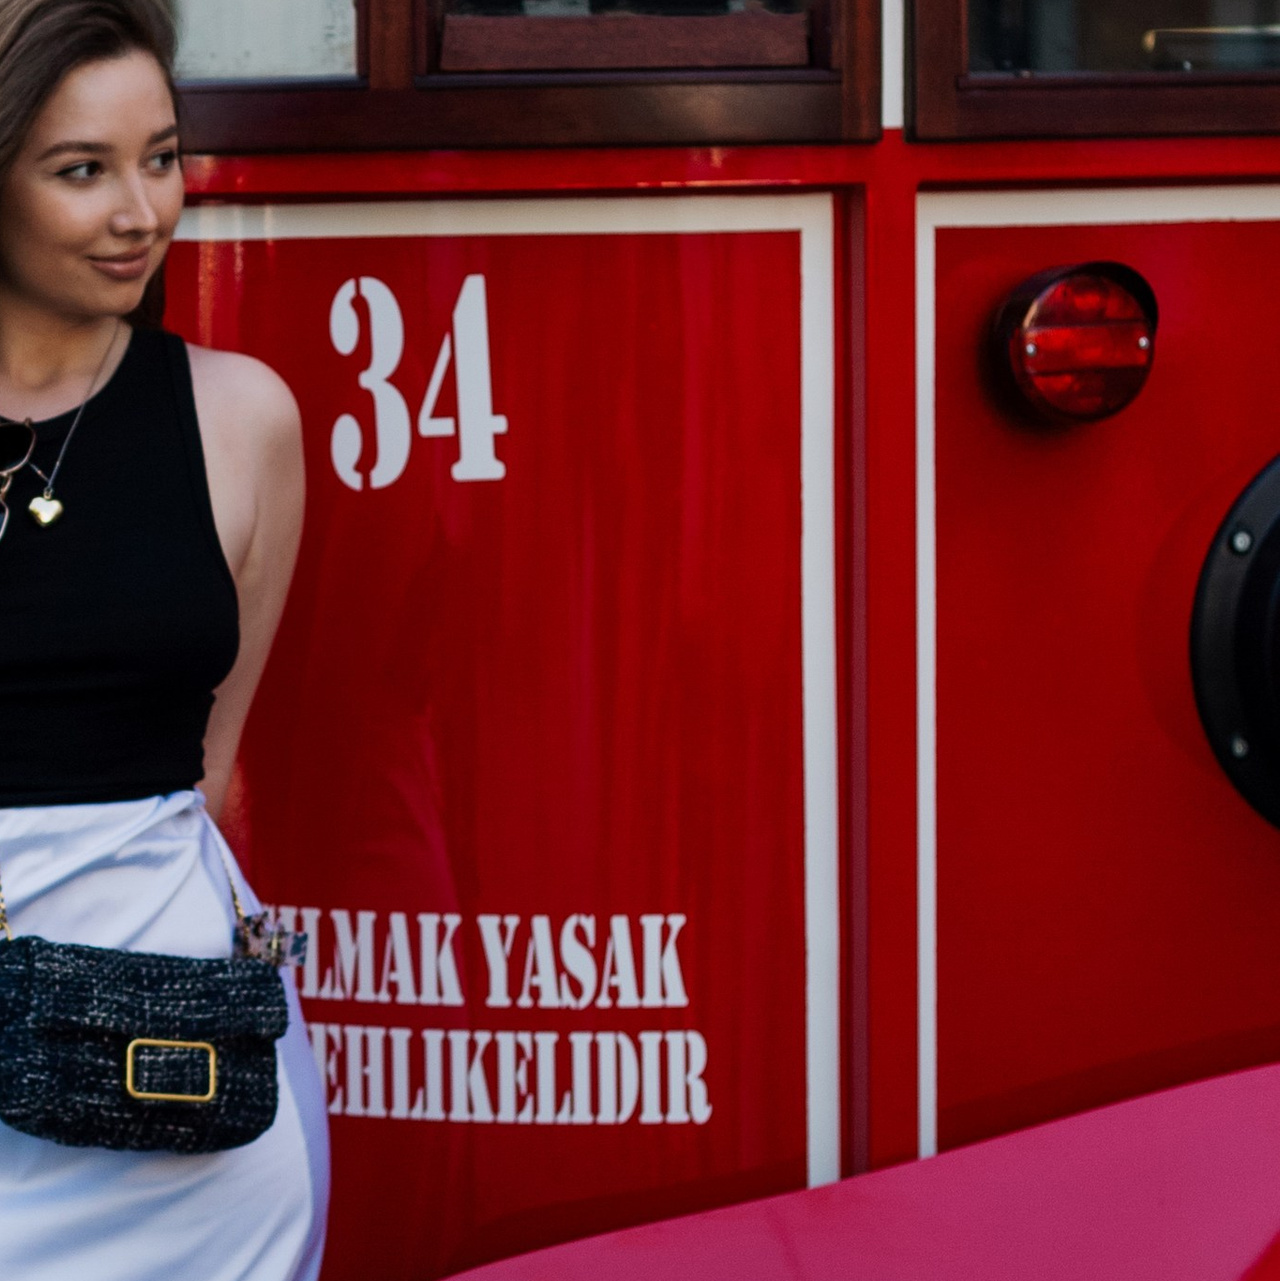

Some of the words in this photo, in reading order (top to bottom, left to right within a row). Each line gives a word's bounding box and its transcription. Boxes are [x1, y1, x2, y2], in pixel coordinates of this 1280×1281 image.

[329, 273, 508, 491] 34
[476, 913, 689, 1010] YASAK
[308, 1022, 713, 1125] EHLIKELIDIR
